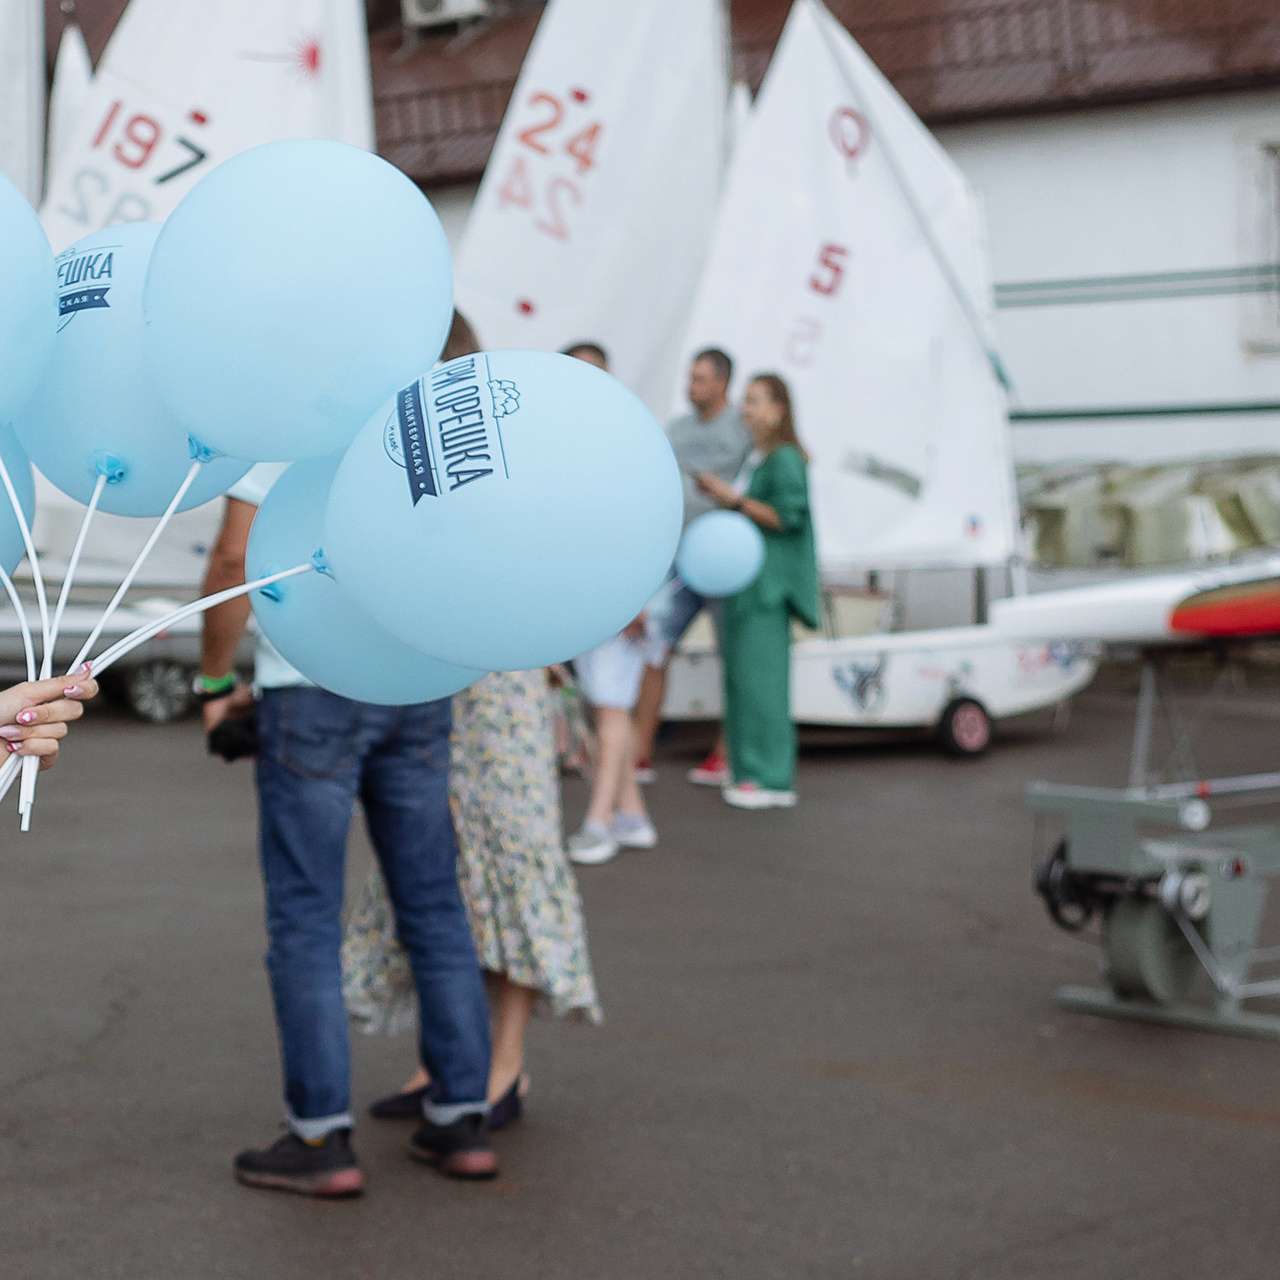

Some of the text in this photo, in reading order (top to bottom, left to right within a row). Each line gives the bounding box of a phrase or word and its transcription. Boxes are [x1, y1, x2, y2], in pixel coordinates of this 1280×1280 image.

[91, 100, 207, 185] 197
[517, 91, 601, 174] 24
[57, 252, 114, 288] ЕШКА
[808, 241, 849, 297] 5
[403, 392, 426, 476] КОНДИТЕРСКАЯ
[433, 385, 494, 492] ОРЕШКА
